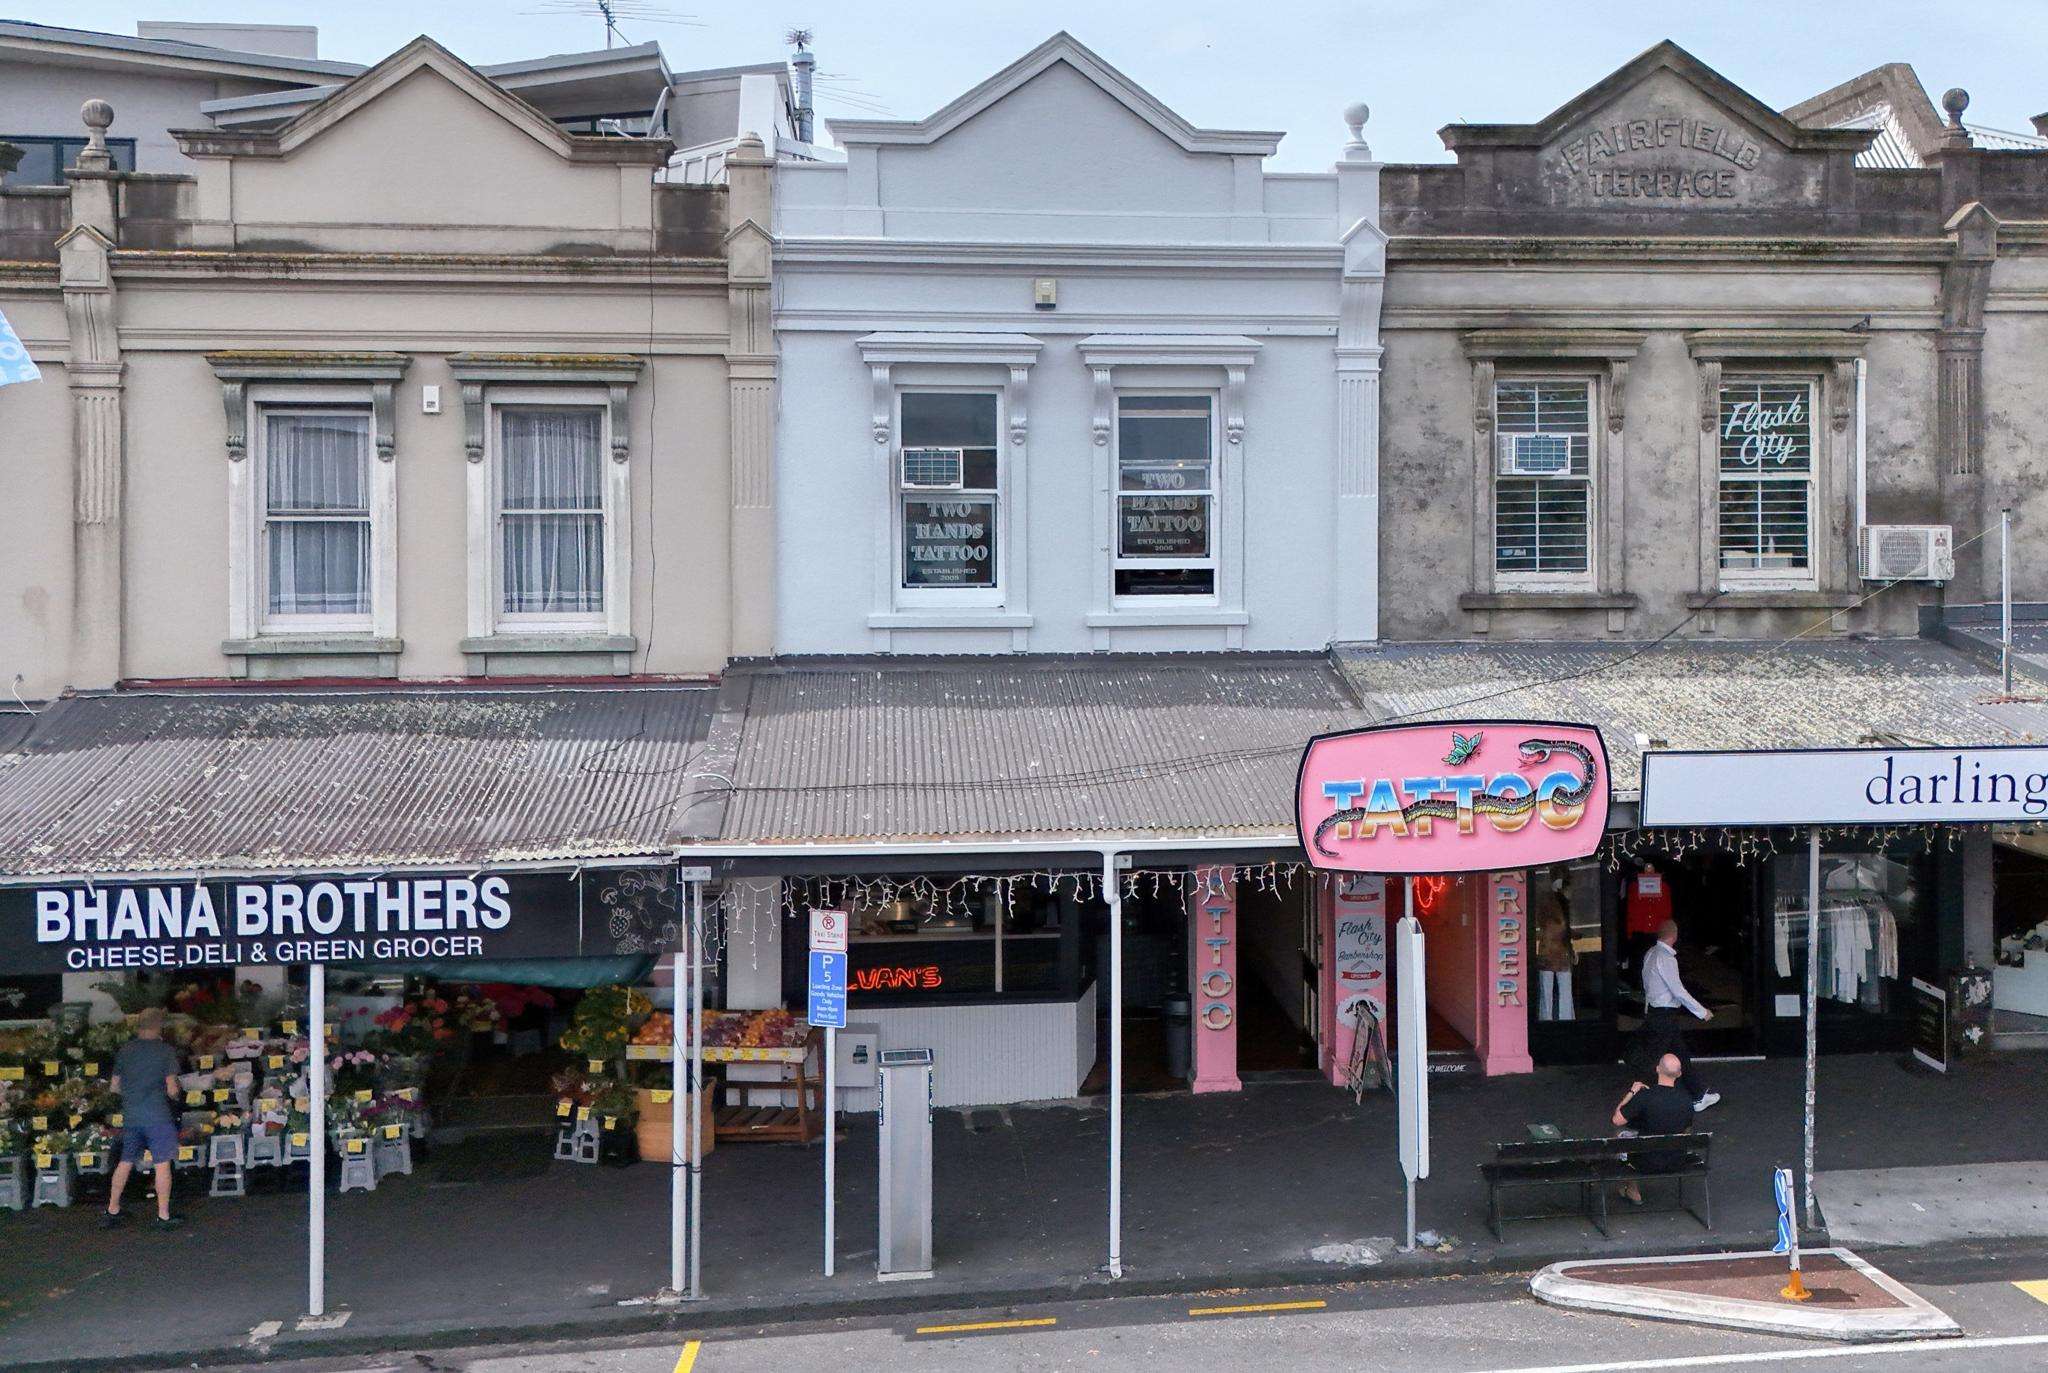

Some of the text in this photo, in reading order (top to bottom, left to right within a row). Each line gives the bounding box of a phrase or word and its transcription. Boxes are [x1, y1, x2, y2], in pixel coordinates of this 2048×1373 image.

[1560, 119, 1761, 174] FAIRFIELD
[1588, 168, 1735, 198] TERRACE
[1725, 394, 1804, 440] Flash
[1740, 431, 1797, 465] City
[1142, 473, 1185, 489] TWO
[927, 502, 972, 518] TWO
[915, 523, 984, 539] HANDS
[1127, 516, 1202, 532] TATTOO
[911, 545, 988, 561] TATTOO
[1865, 754, 2048, 815] darling
[1321, 770, 1586, 840] TATTOO
[36, 885, 222, 943] BHANA
[236, 876, 512, 936] BROTHERS
[1338, 917, 1373, 938] Flash
[1358, 931, 1383, 946] City
[66, 936, 484, 969] CHEESE,DELI & GREEN GROCER
[822, 954, 834, 969] P
[1201, 874, 1234, 1031] ATTOO
[824, 971, 832, 983] 5
[848, 966, 942, 991] VAN'S
